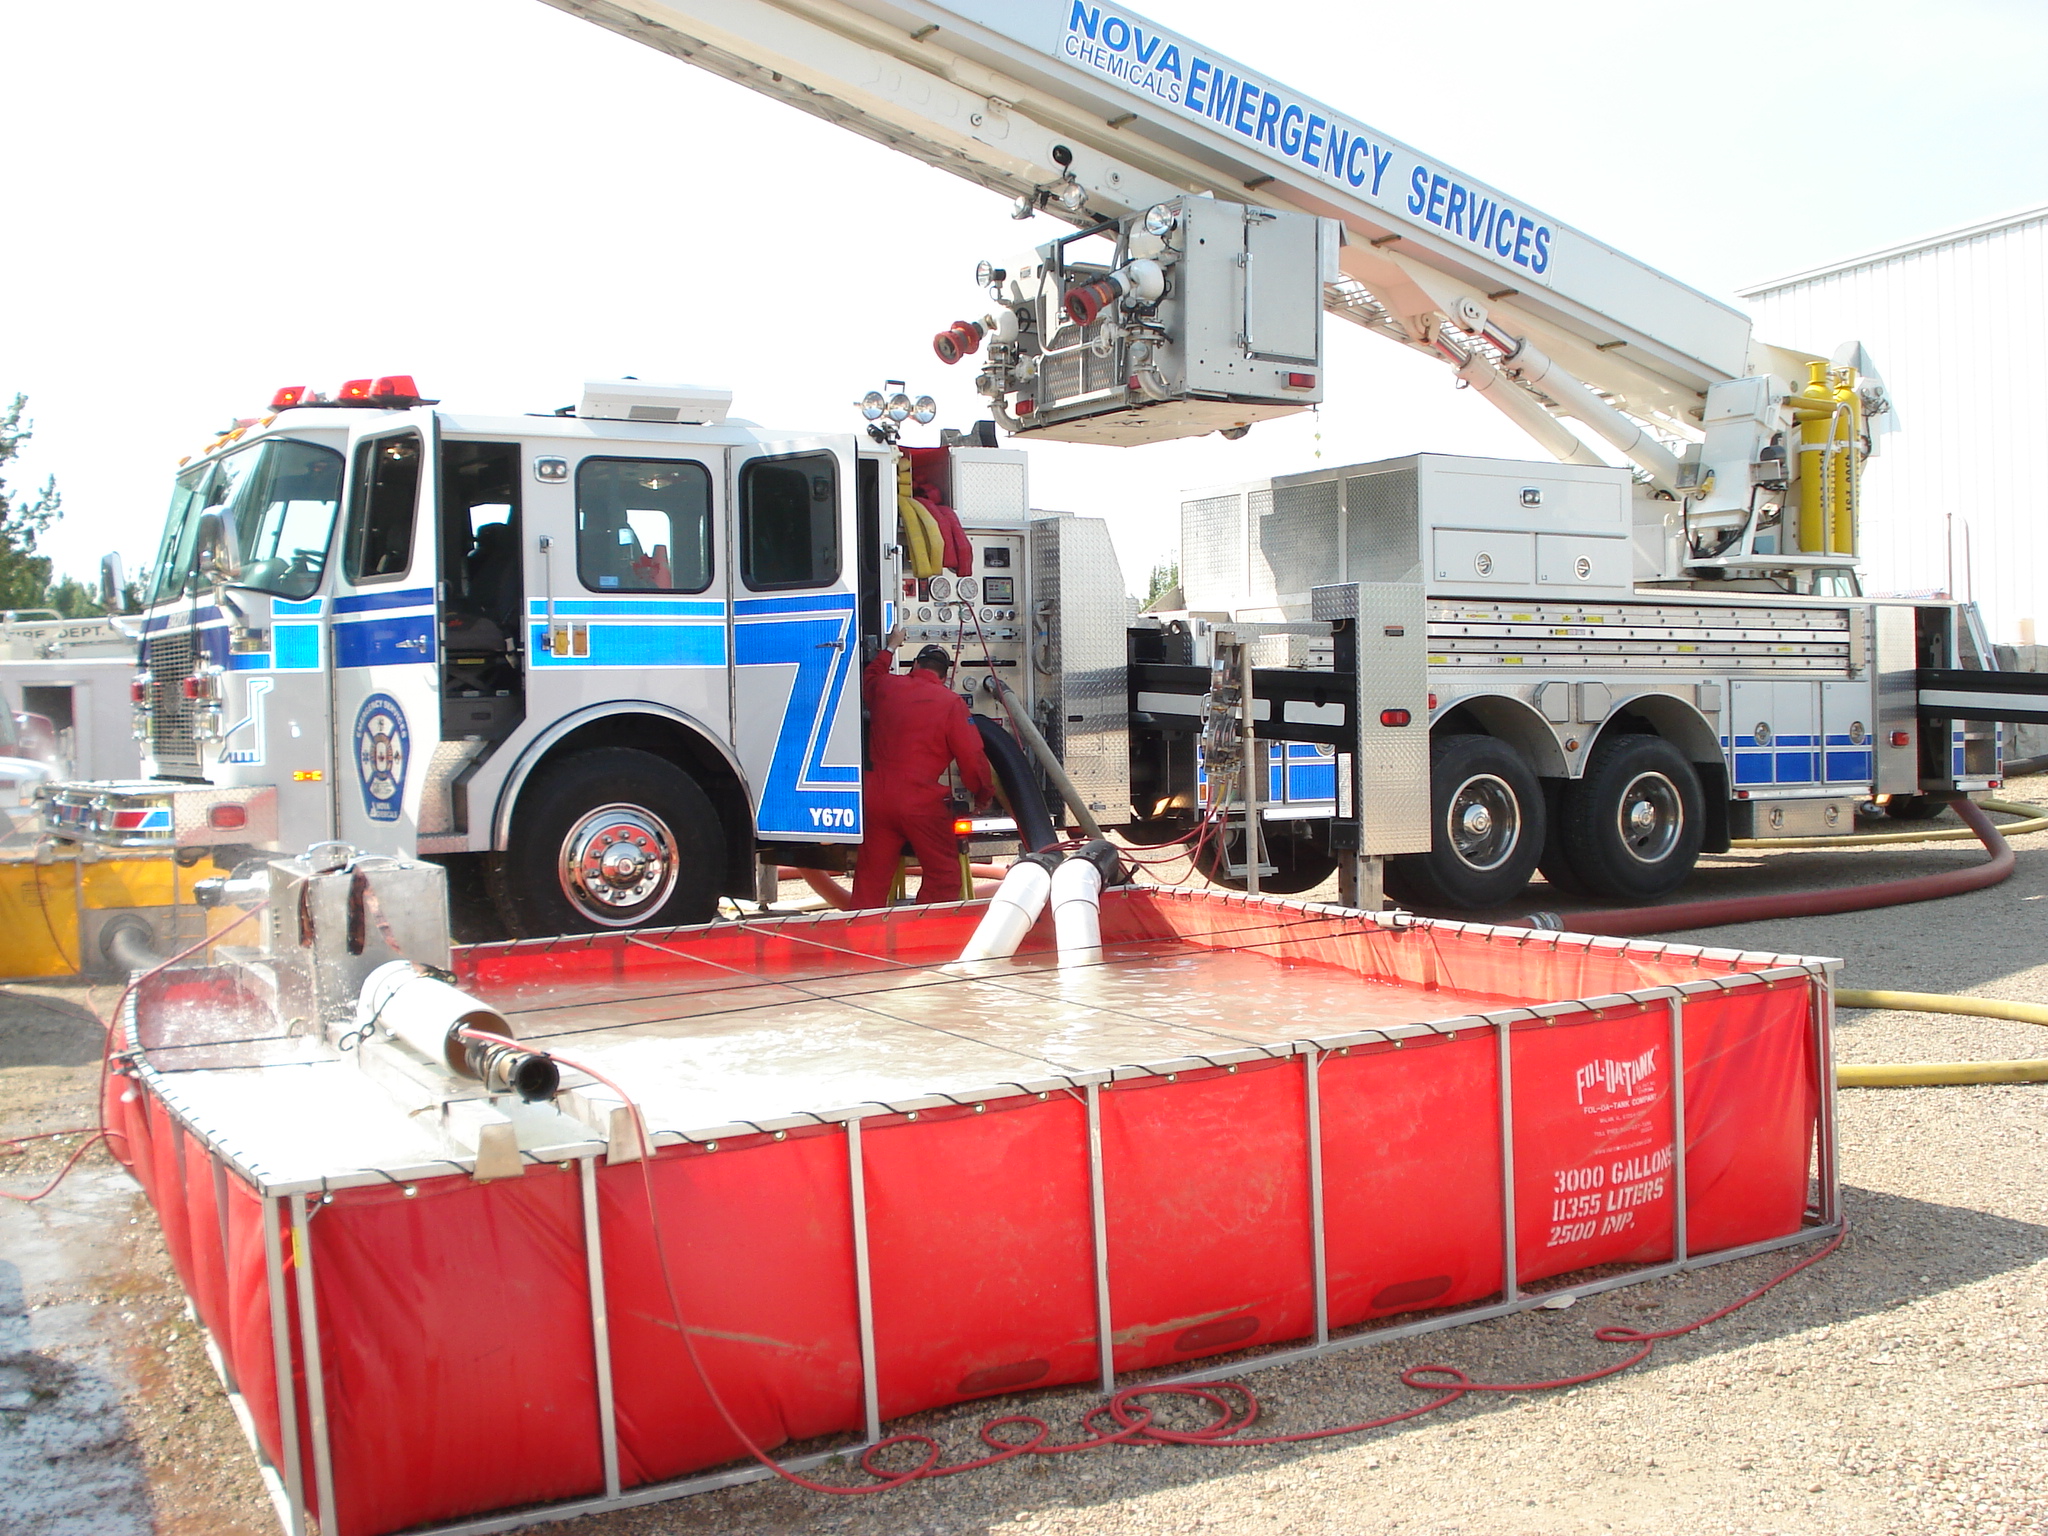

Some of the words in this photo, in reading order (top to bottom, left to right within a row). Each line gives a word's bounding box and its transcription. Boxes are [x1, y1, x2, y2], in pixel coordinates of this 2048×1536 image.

[1068, 0, 1183, 82] NOVA
[1065, 35, 1180, 104] CHEMICALS
[1184, 57, 1393, 197] EMERGENCY
[1406, 165, 1552, 275] SERVICES
[809, 807, 855, 828] Y670
[1552, 1193, 1602, 1222] 11355
[1607, 1177, 1664, 1212] LITERS
[1553, 1164, 1604, 1194] 3000
[1547, 1220, 1597, 1247] 2500
[1601, 1211, 1635, 1236] IMP.
